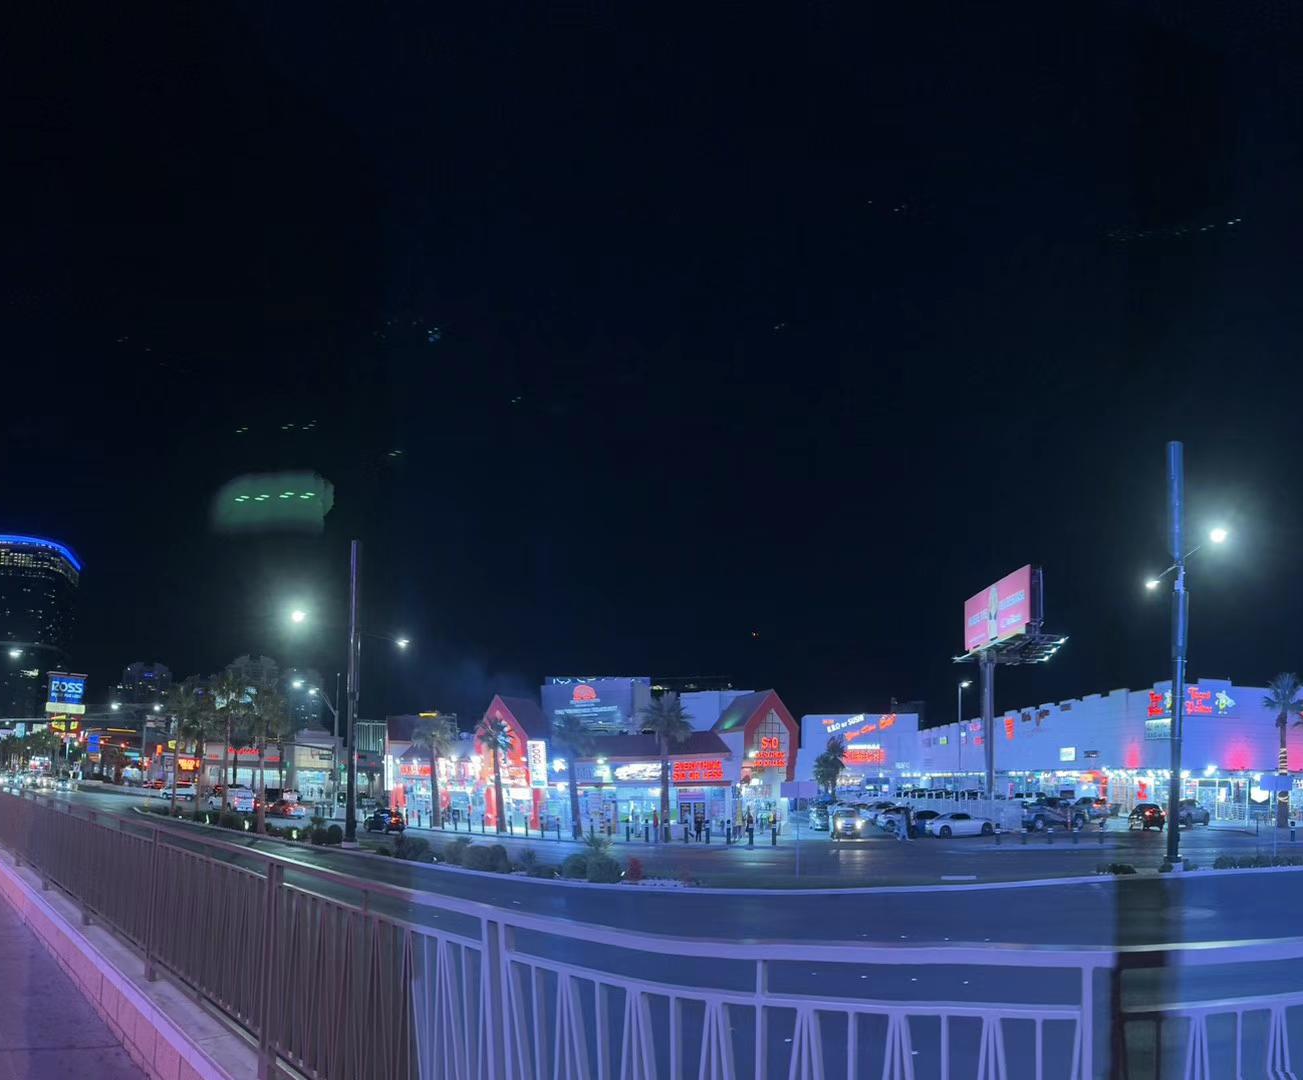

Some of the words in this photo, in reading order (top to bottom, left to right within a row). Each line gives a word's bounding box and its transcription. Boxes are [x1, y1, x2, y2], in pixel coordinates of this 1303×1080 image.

[51, 680, 84, 694] ROSS
[673, 760, 722, 771] EVERYTHING
[703, 769, 723, 779] LESS
